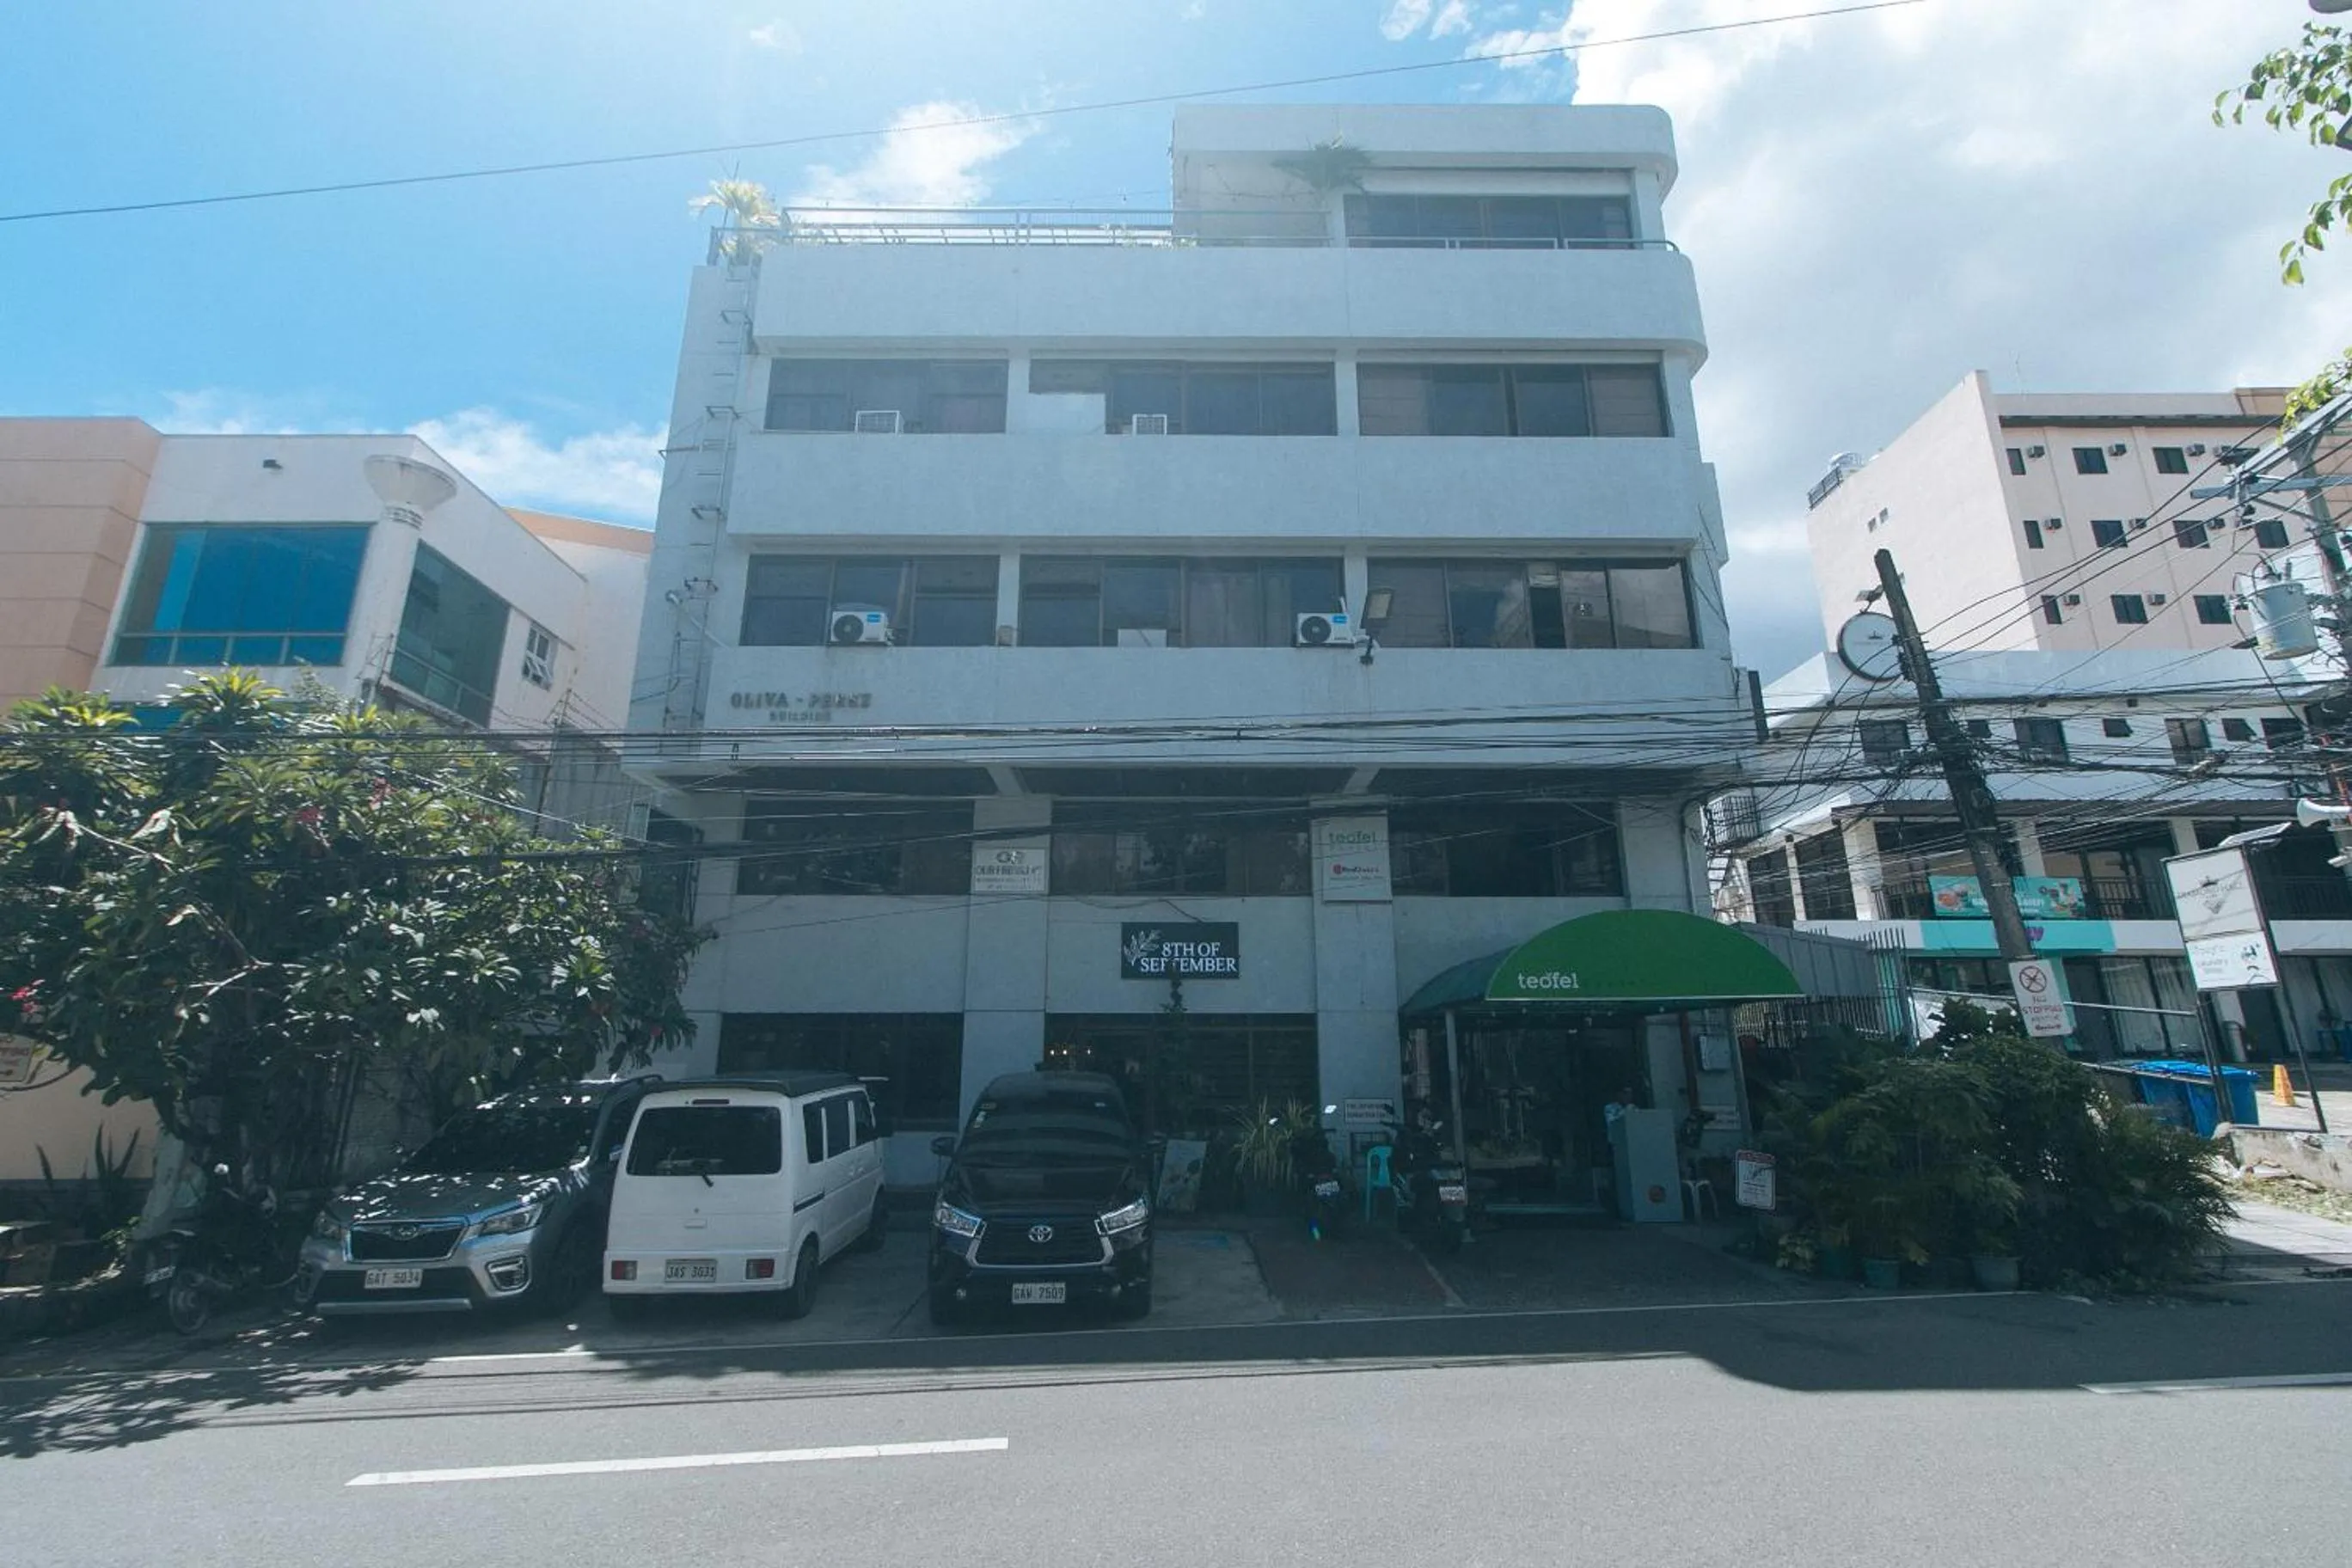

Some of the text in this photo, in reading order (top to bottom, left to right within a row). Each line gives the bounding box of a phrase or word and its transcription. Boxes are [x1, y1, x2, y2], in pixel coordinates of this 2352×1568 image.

[731, 692, 789, 708] OLIVA
[1161, 942, 1221, 957] 8TH OF
